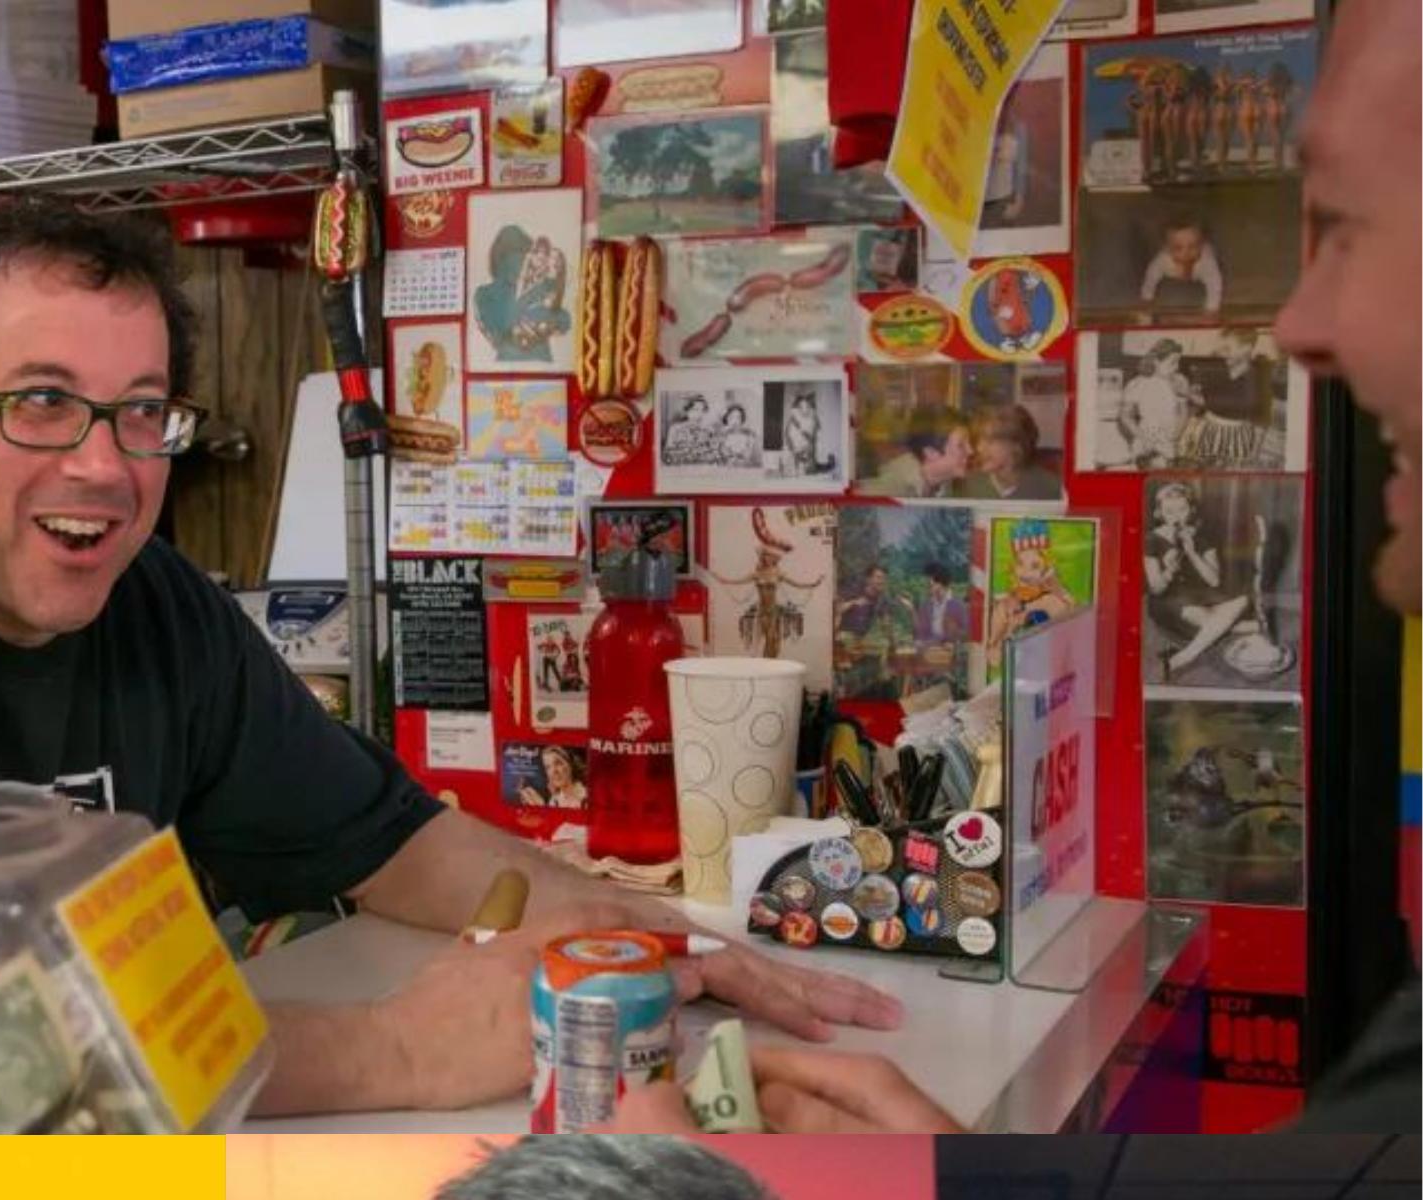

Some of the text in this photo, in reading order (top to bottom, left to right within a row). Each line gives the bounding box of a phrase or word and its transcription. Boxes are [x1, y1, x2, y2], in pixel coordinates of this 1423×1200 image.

[395, 167, 475, 189] BIG WEENIE
[404, 559, 480, 584] BLACK
[1030, 732, 1081, 840] CASH
